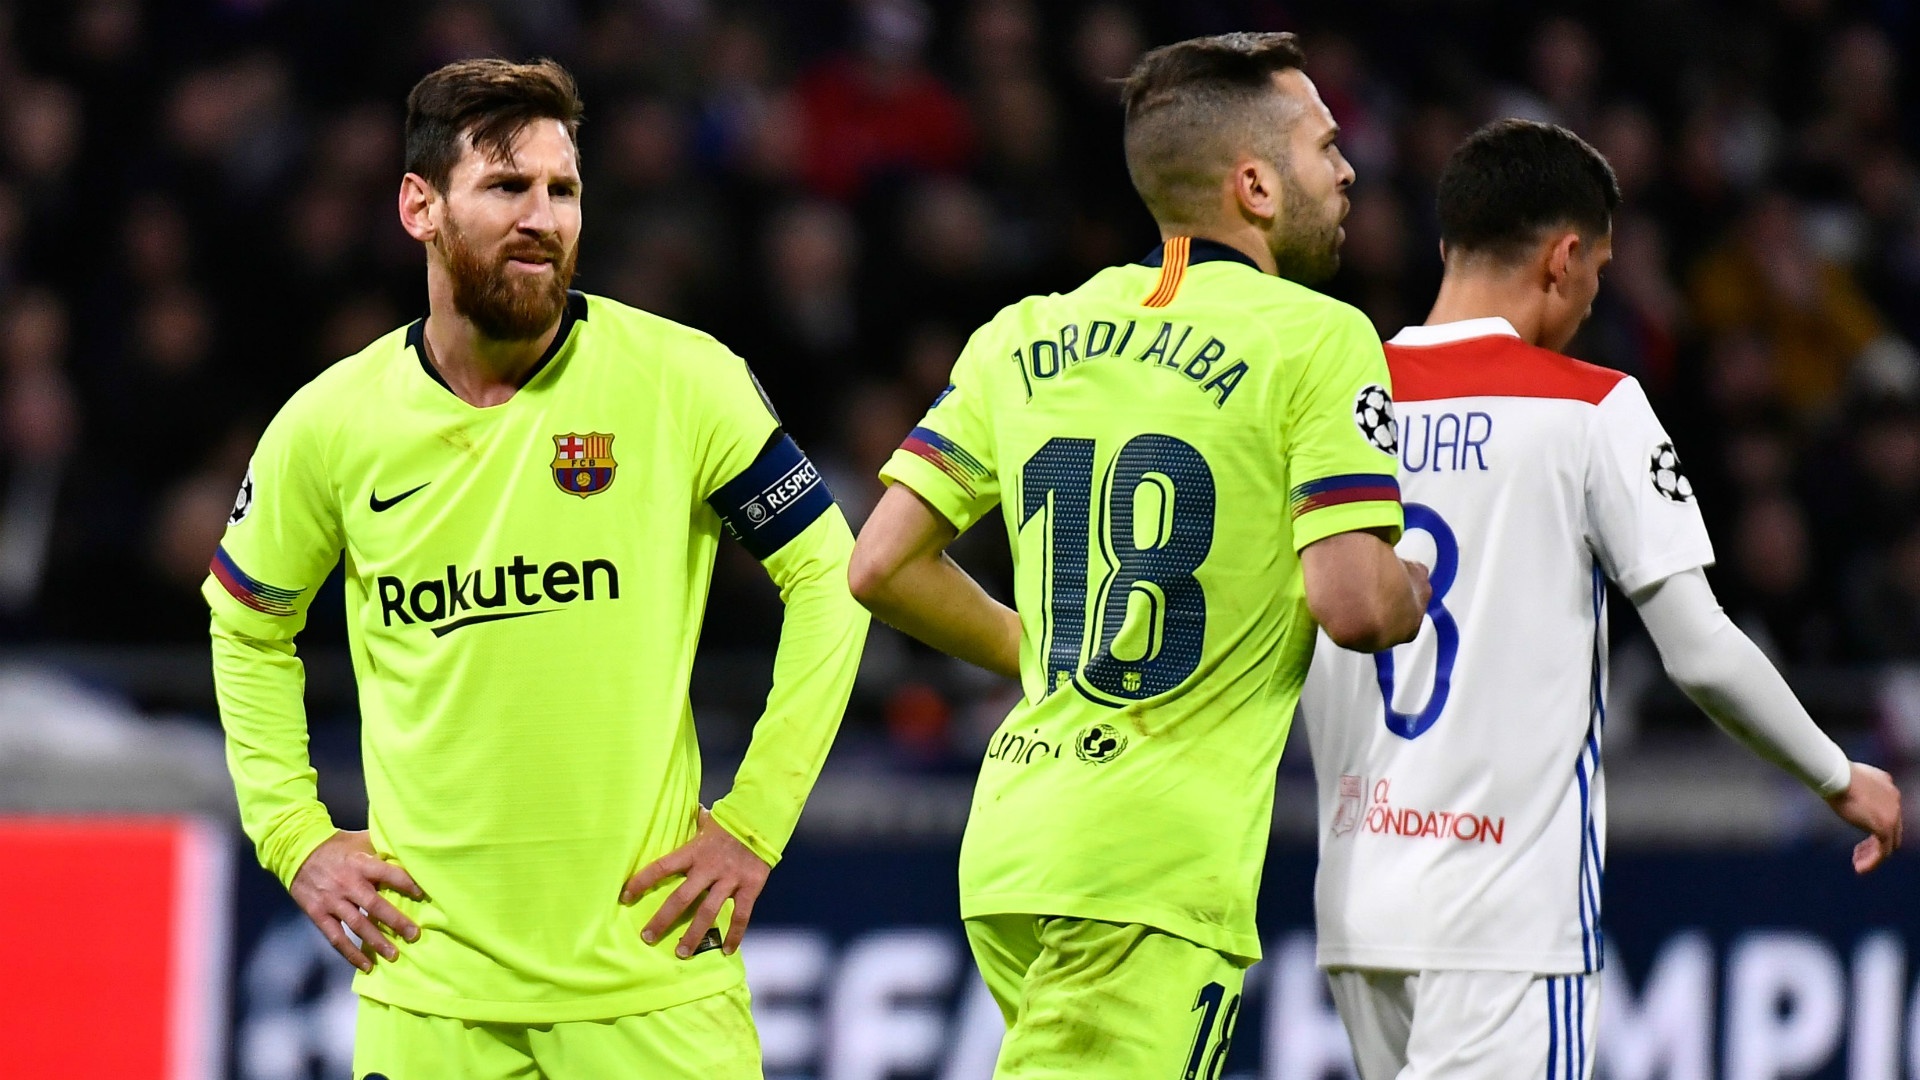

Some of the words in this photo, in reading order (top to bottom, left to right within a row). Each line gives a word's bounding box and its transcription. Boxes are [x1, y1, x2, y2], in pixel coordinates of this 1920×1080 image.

[1011, 320, 1136, 405] JORDI
[1134, 321, 1249, 409] ALBA
[1394, 412, 1492, 473] UAR
[378, 555, 619, 627] Rakuten
[1015, 433, 1216, 709] 18
